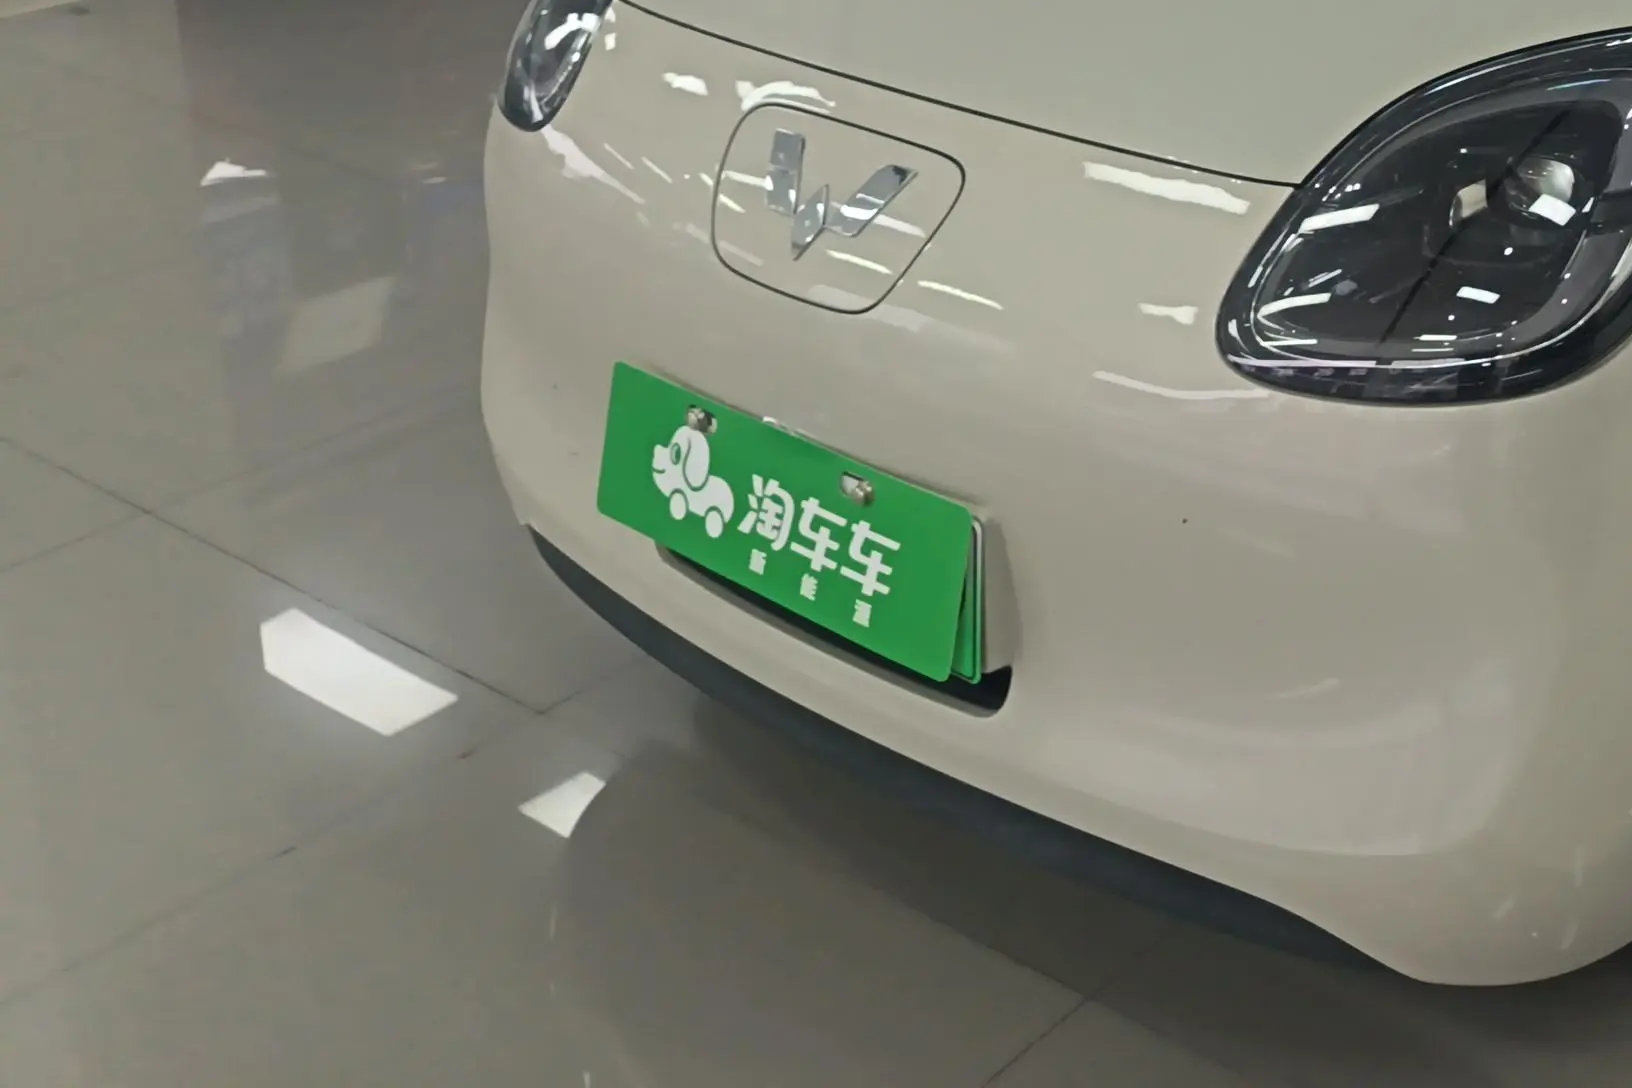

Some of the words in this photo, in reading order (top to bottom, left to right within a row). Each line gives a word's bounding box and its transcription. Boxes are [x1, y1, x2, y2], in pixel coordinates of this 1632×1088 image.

[738, 474, 901, 596] 淘车车
[749, 548, 872, 628] 新能源
